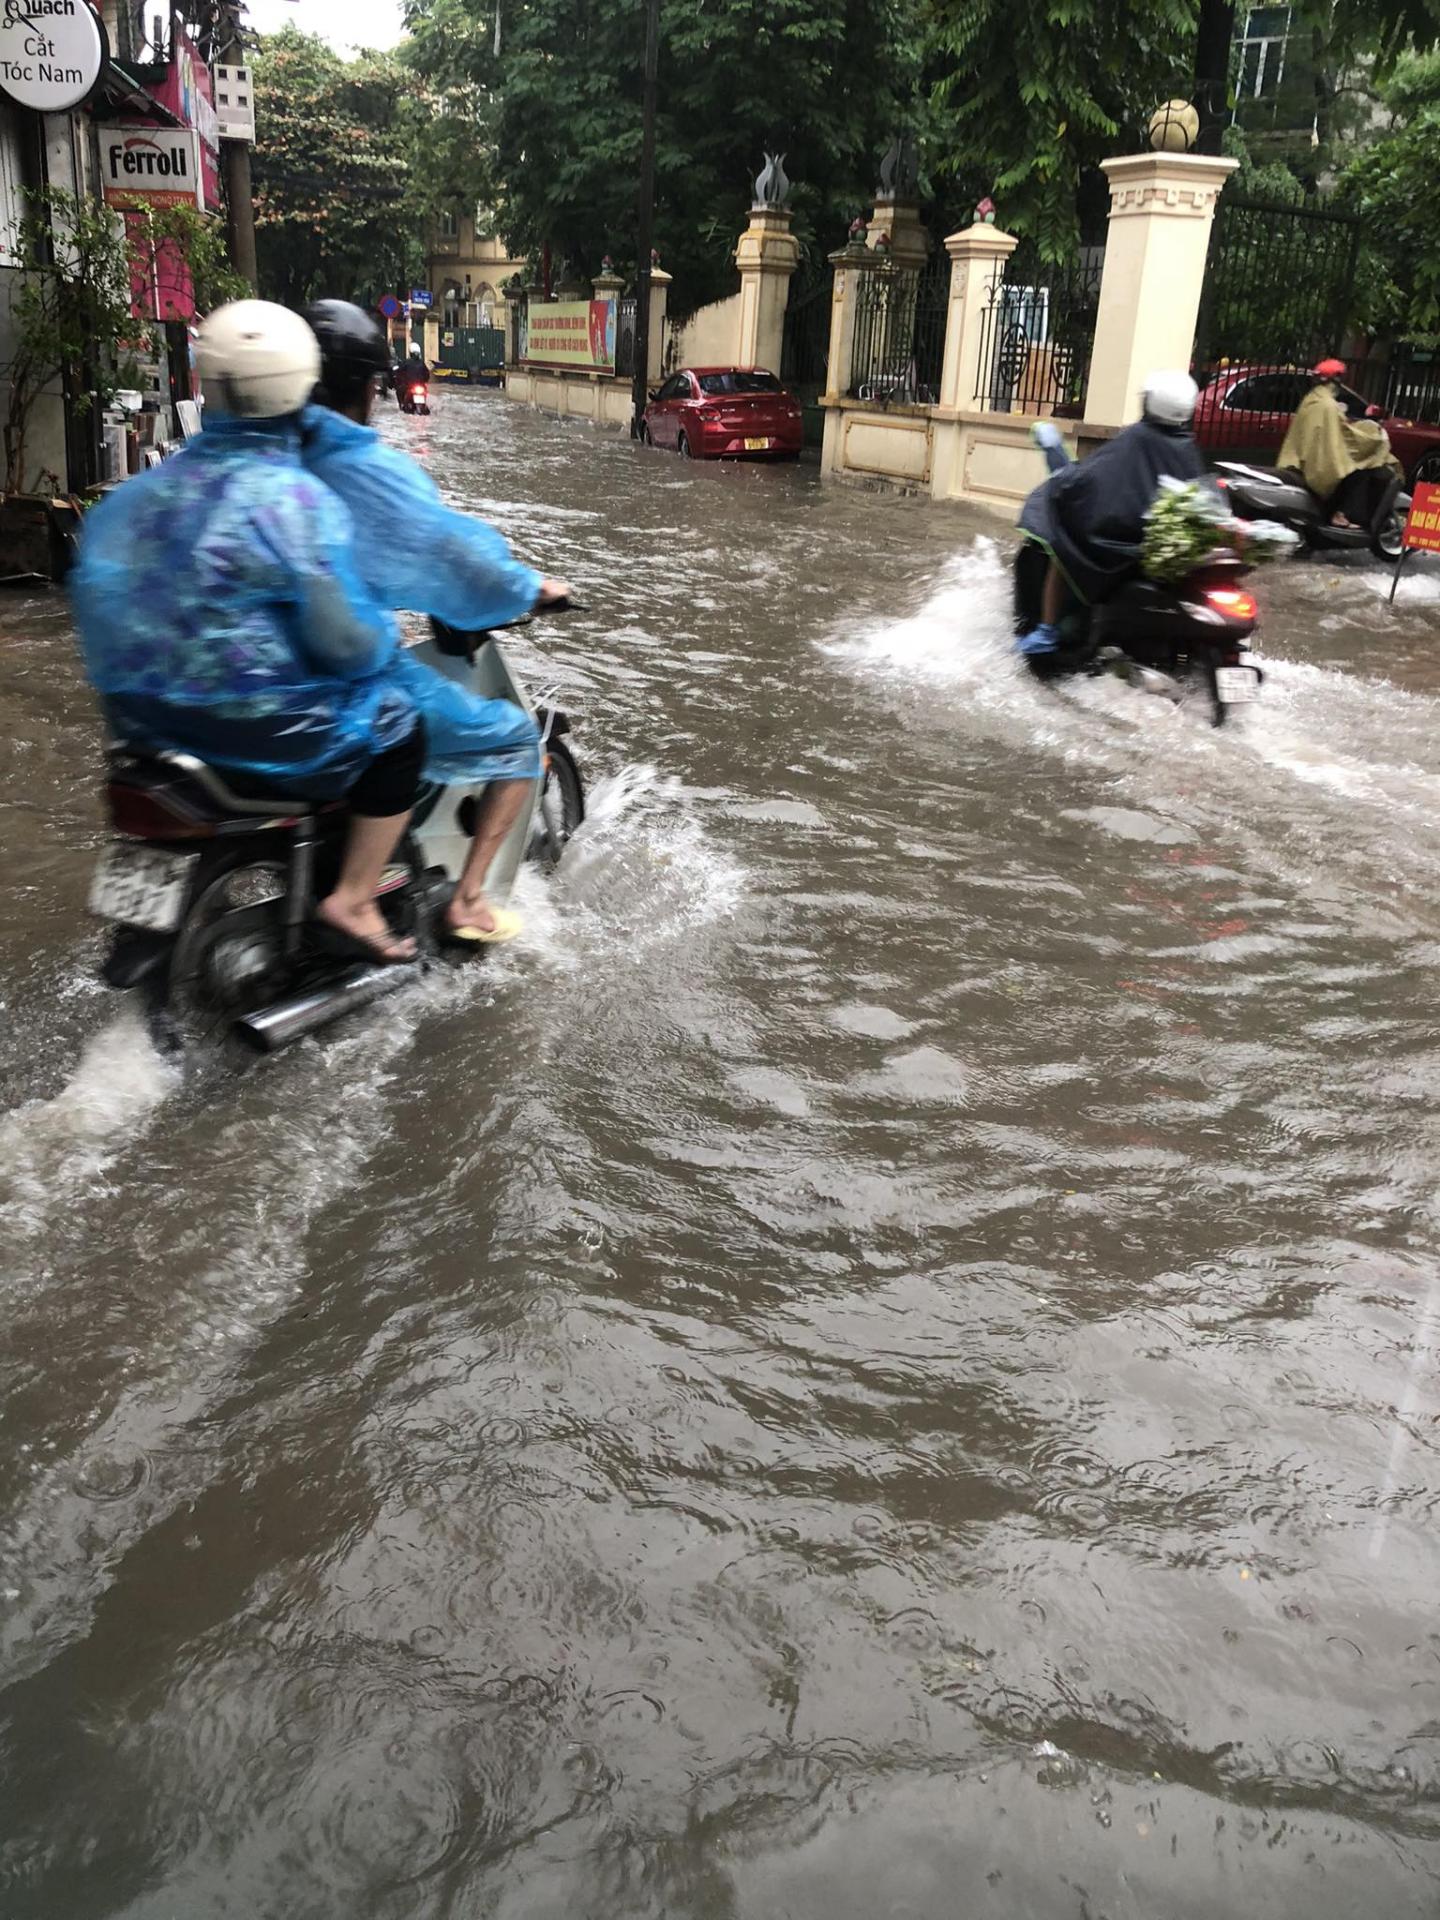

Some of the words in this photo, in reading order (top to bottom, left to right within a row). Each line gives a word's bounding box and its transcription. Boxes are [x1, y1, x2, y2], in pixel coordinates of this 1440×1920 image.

[24, 33, 55, 57] Cắt
[0, 61, 33, 81] Tóc
[39, 63, 83, 84] Nam
